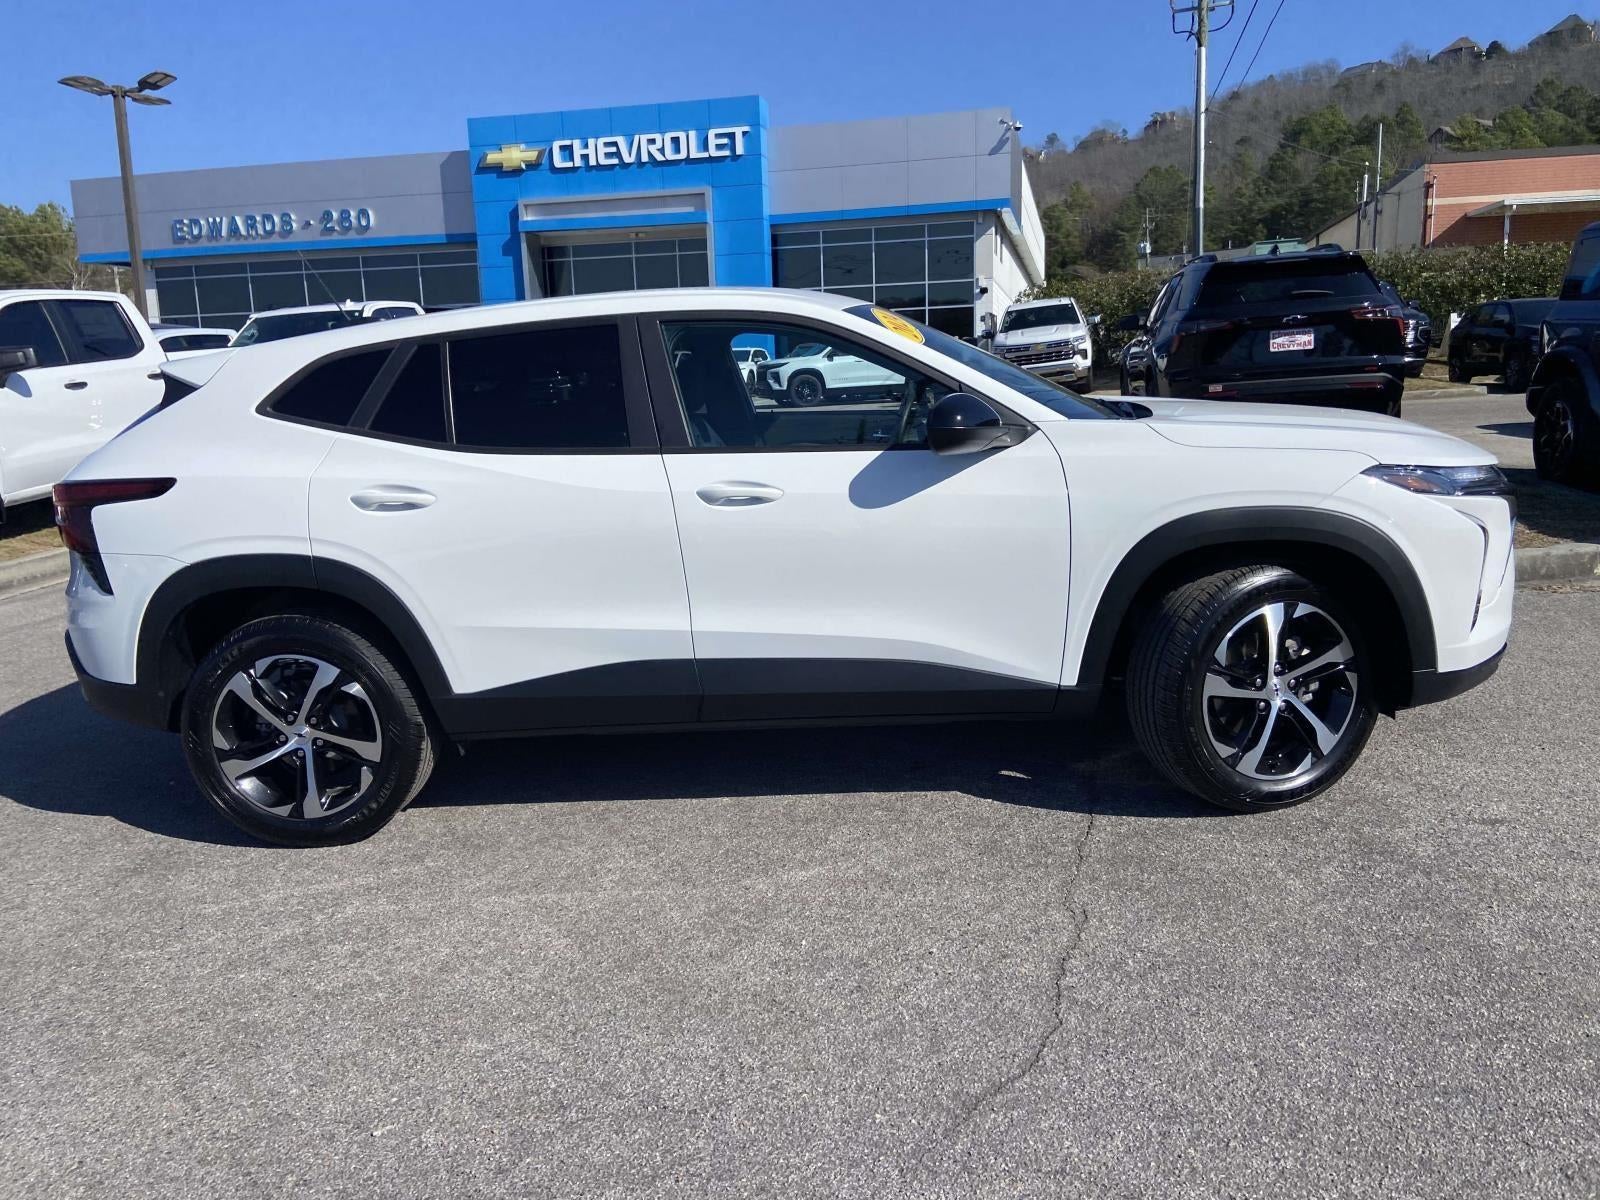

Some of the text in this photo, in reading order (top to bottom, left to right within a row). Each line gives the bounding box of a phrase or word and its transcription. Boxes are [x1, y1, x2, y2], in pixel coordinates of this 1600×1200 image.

[552, 126, 750, 168] CHEVROLET
[172, 212, 295, 242] EDWARDS
[320, 208, 373, 234] 280
[1272, 339, 1312, 350] CHEVYMAN
